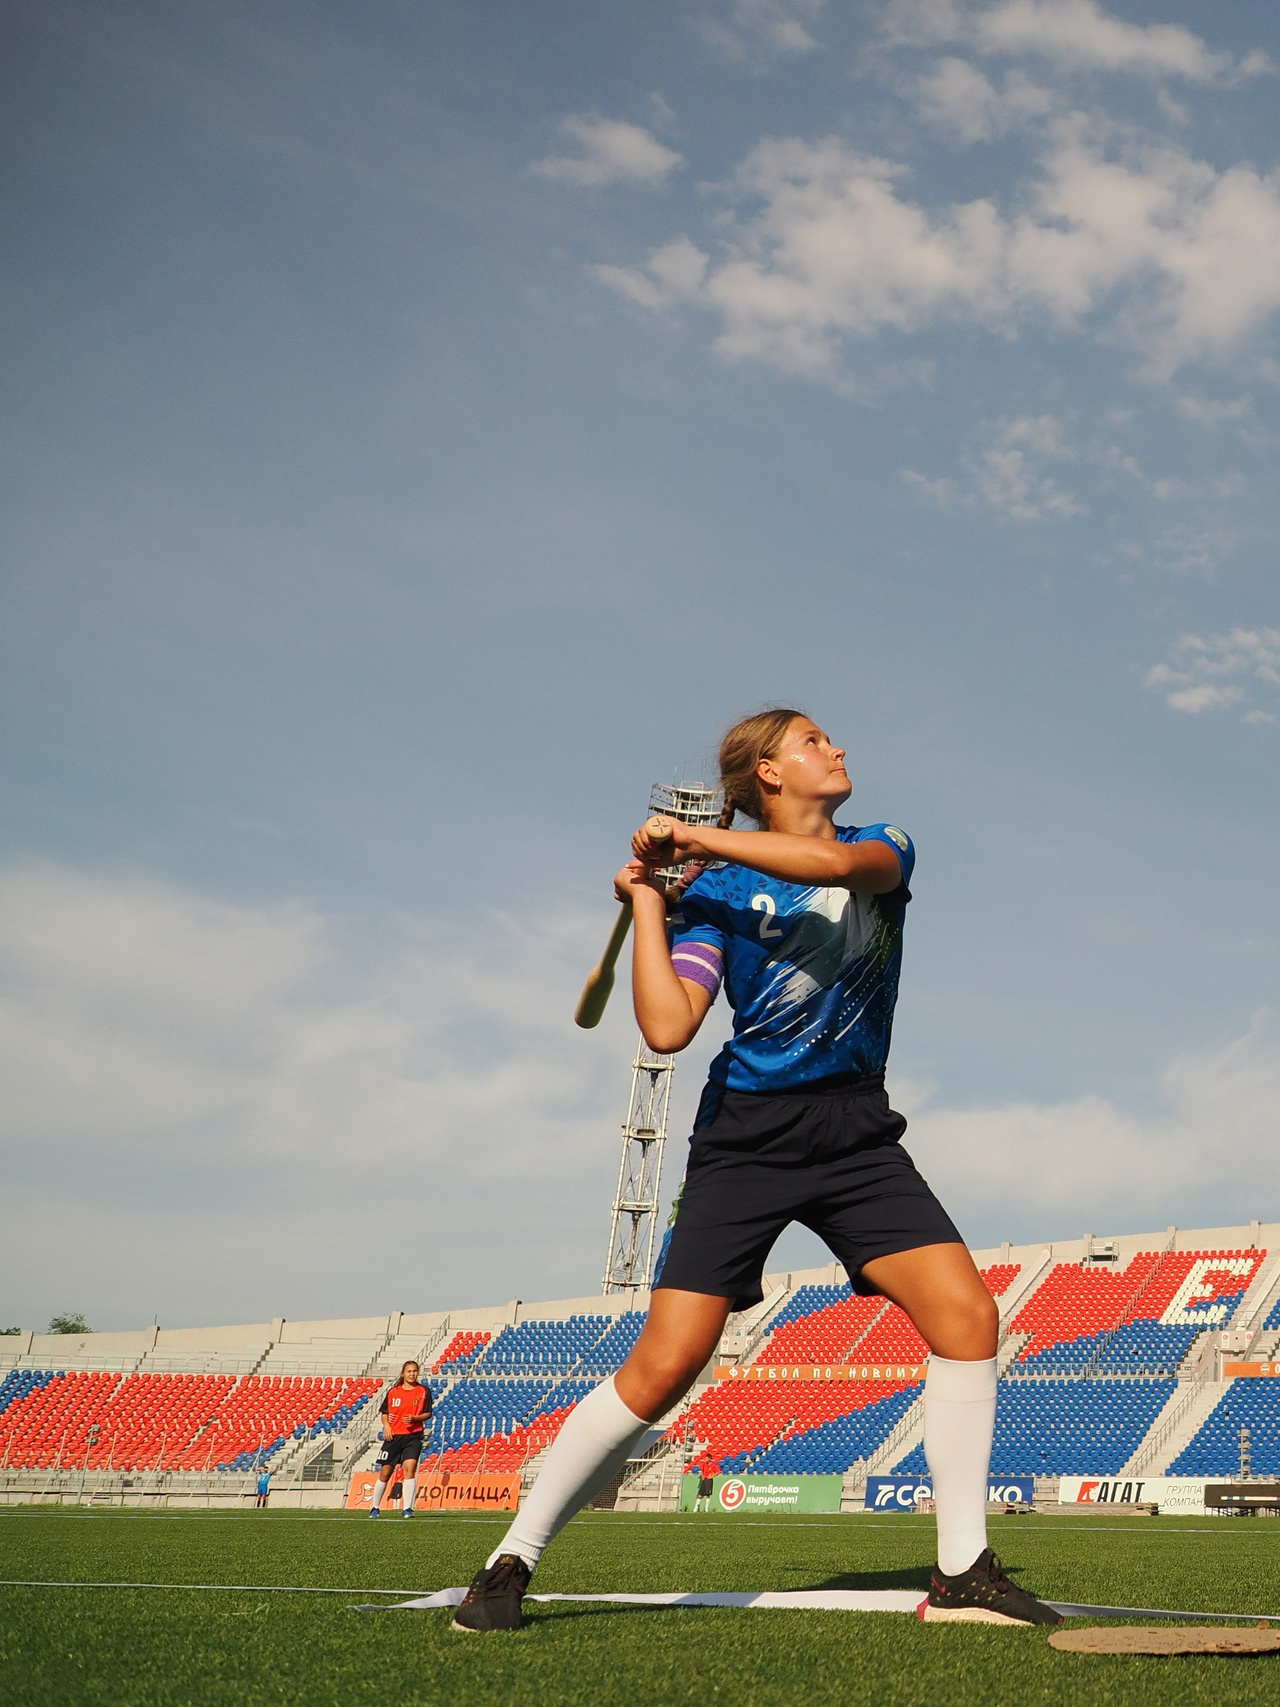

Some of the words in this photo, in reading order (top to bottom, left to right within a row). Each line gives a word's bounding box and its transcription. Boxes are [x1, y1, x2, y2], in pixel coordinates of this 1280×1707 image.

[751, 894, 782, 939] 2
[728, 1366, 799, 1379] ФУТБОЛ
[813, 1366, 919, 1378] ПО-НОВОМУ
[391, 1397, 401, 1407] 10
[446, 1485, 512, 1503] ПИЦЦА
[748, 1484, 800, 1495] Пятёрочка
[1096, 1482, 1146, 1503] АГАТ
[1166, 1485, 1203, 1495] ГРУППА
[746, 1495, 798, 1506] выручает!
